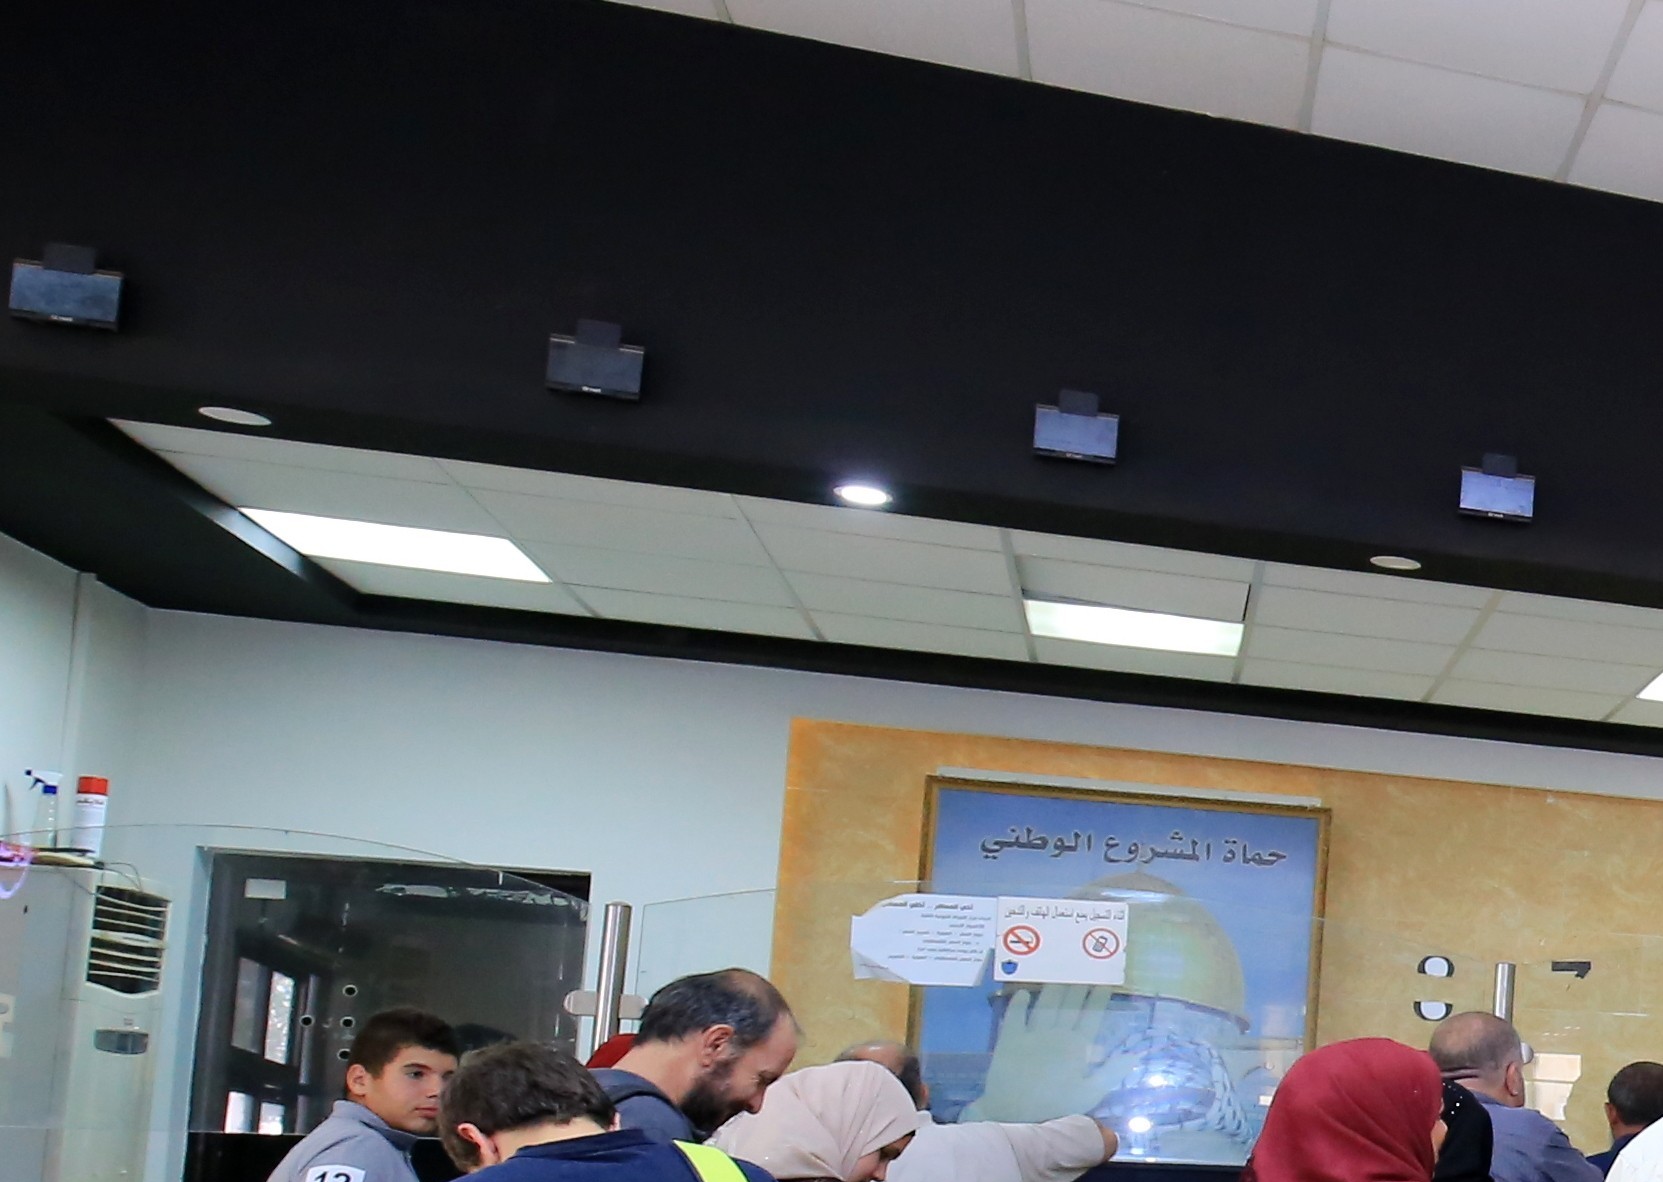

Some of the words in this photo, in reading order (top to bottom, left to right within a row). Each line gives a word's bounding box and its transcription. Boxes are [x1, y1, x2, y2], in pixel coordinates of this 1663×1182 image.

[979, 826, 1093, 860] الوطني
[1103, 828, 1212, 864] المشروع
[1221, 838, 1288, 866] حماة
